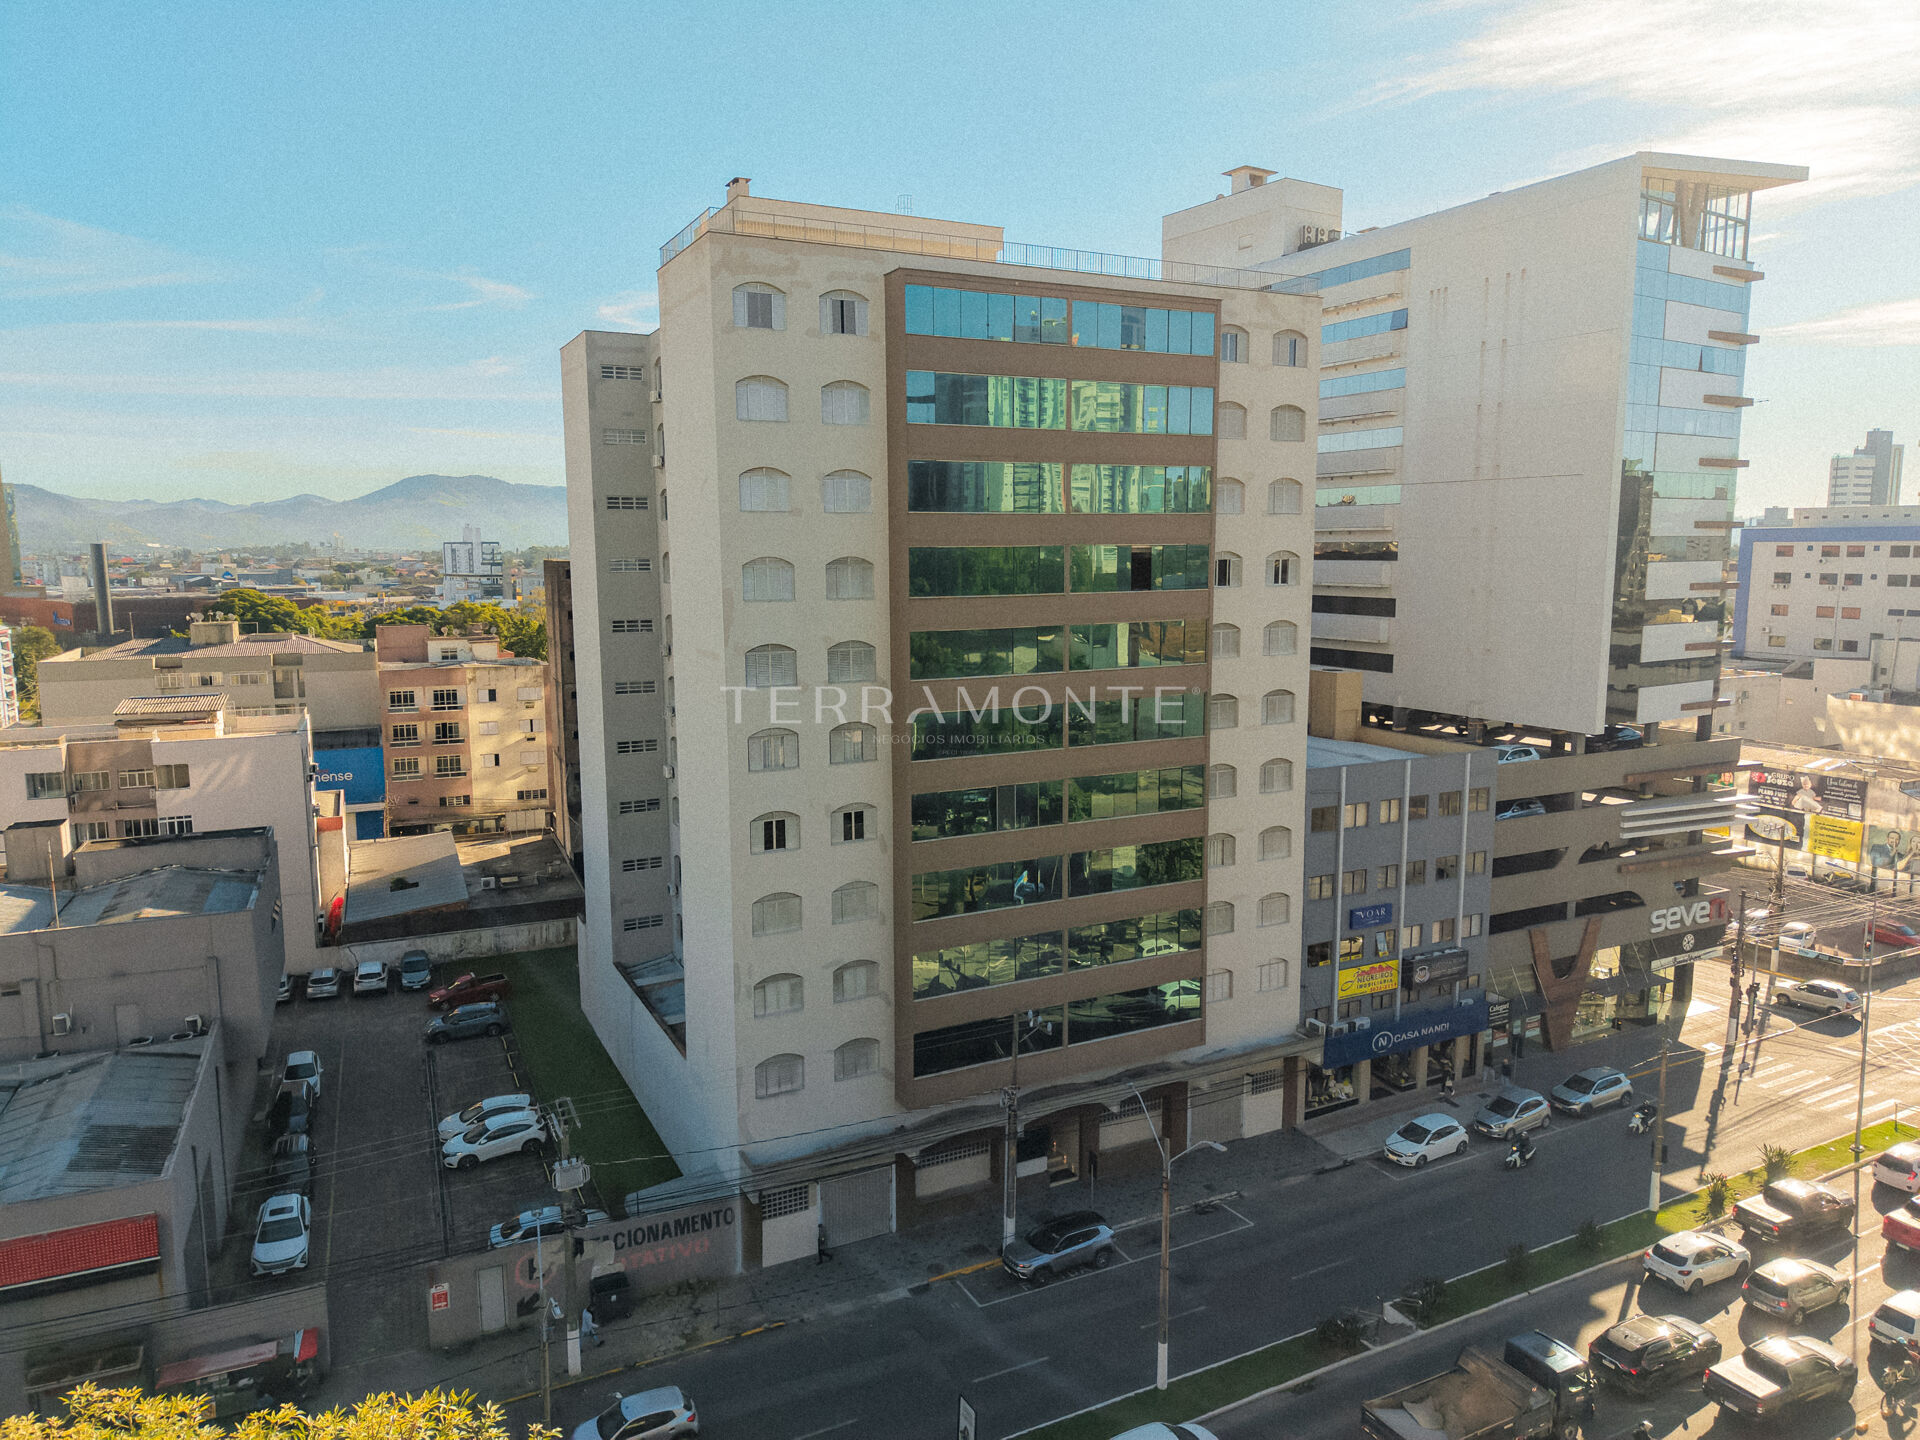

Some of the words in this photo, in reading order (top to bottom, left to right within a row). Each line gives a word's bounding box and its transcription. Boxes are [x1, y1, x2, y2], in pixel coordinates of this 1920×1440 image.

[1355, 907, 1386, 920] VOAR
[1357, 971, 1393, 983] NEGREIROS
[1393, 1030, 1419, 1043] CASA
[1421, 1022, 1450, 1037] NANDI
[590, 1207, 736, 1251] CIONAMENTO
